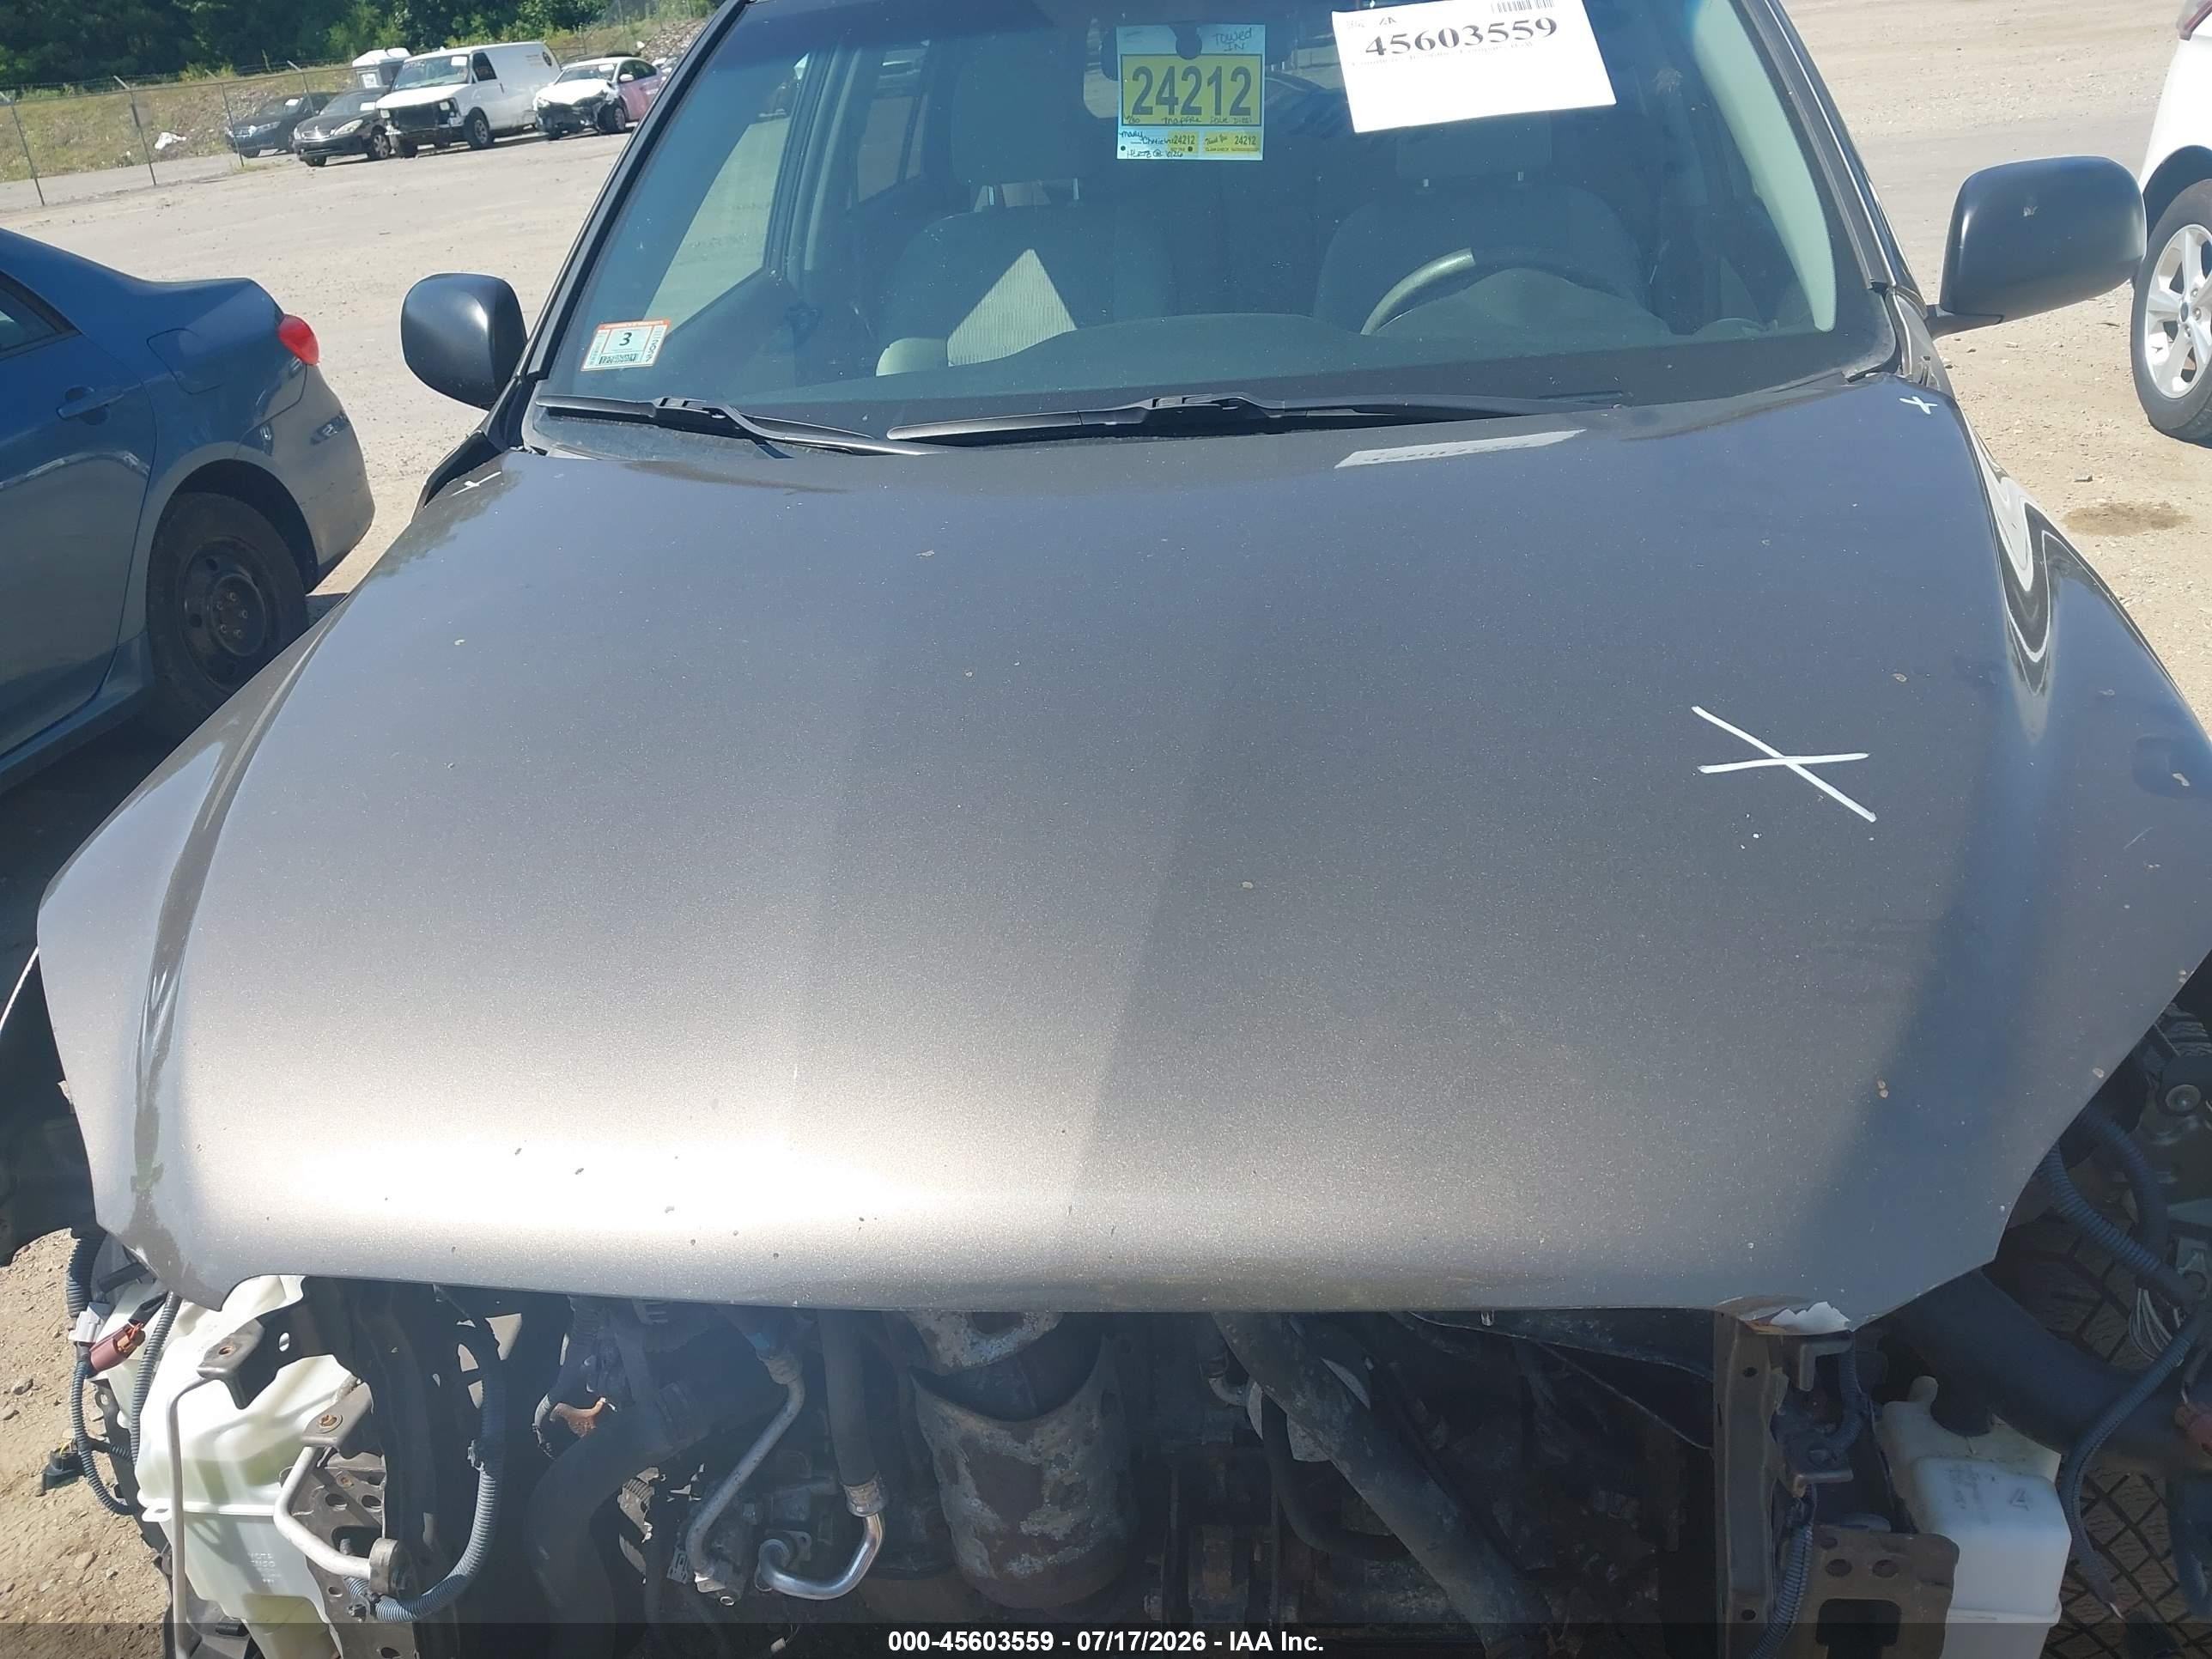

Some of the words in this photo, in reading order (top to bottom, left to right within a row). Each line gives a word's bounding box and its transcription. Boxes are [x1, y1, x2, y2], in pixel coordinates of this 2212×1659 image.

[1365, 16, 1558, 56] 45603559
[1132, 65, 1252, 116] 24212
[1173, 135, 1195, 144] 24212
[1235, 136, 1256, 145] 24212
[619, 331, 632, 346] 3
